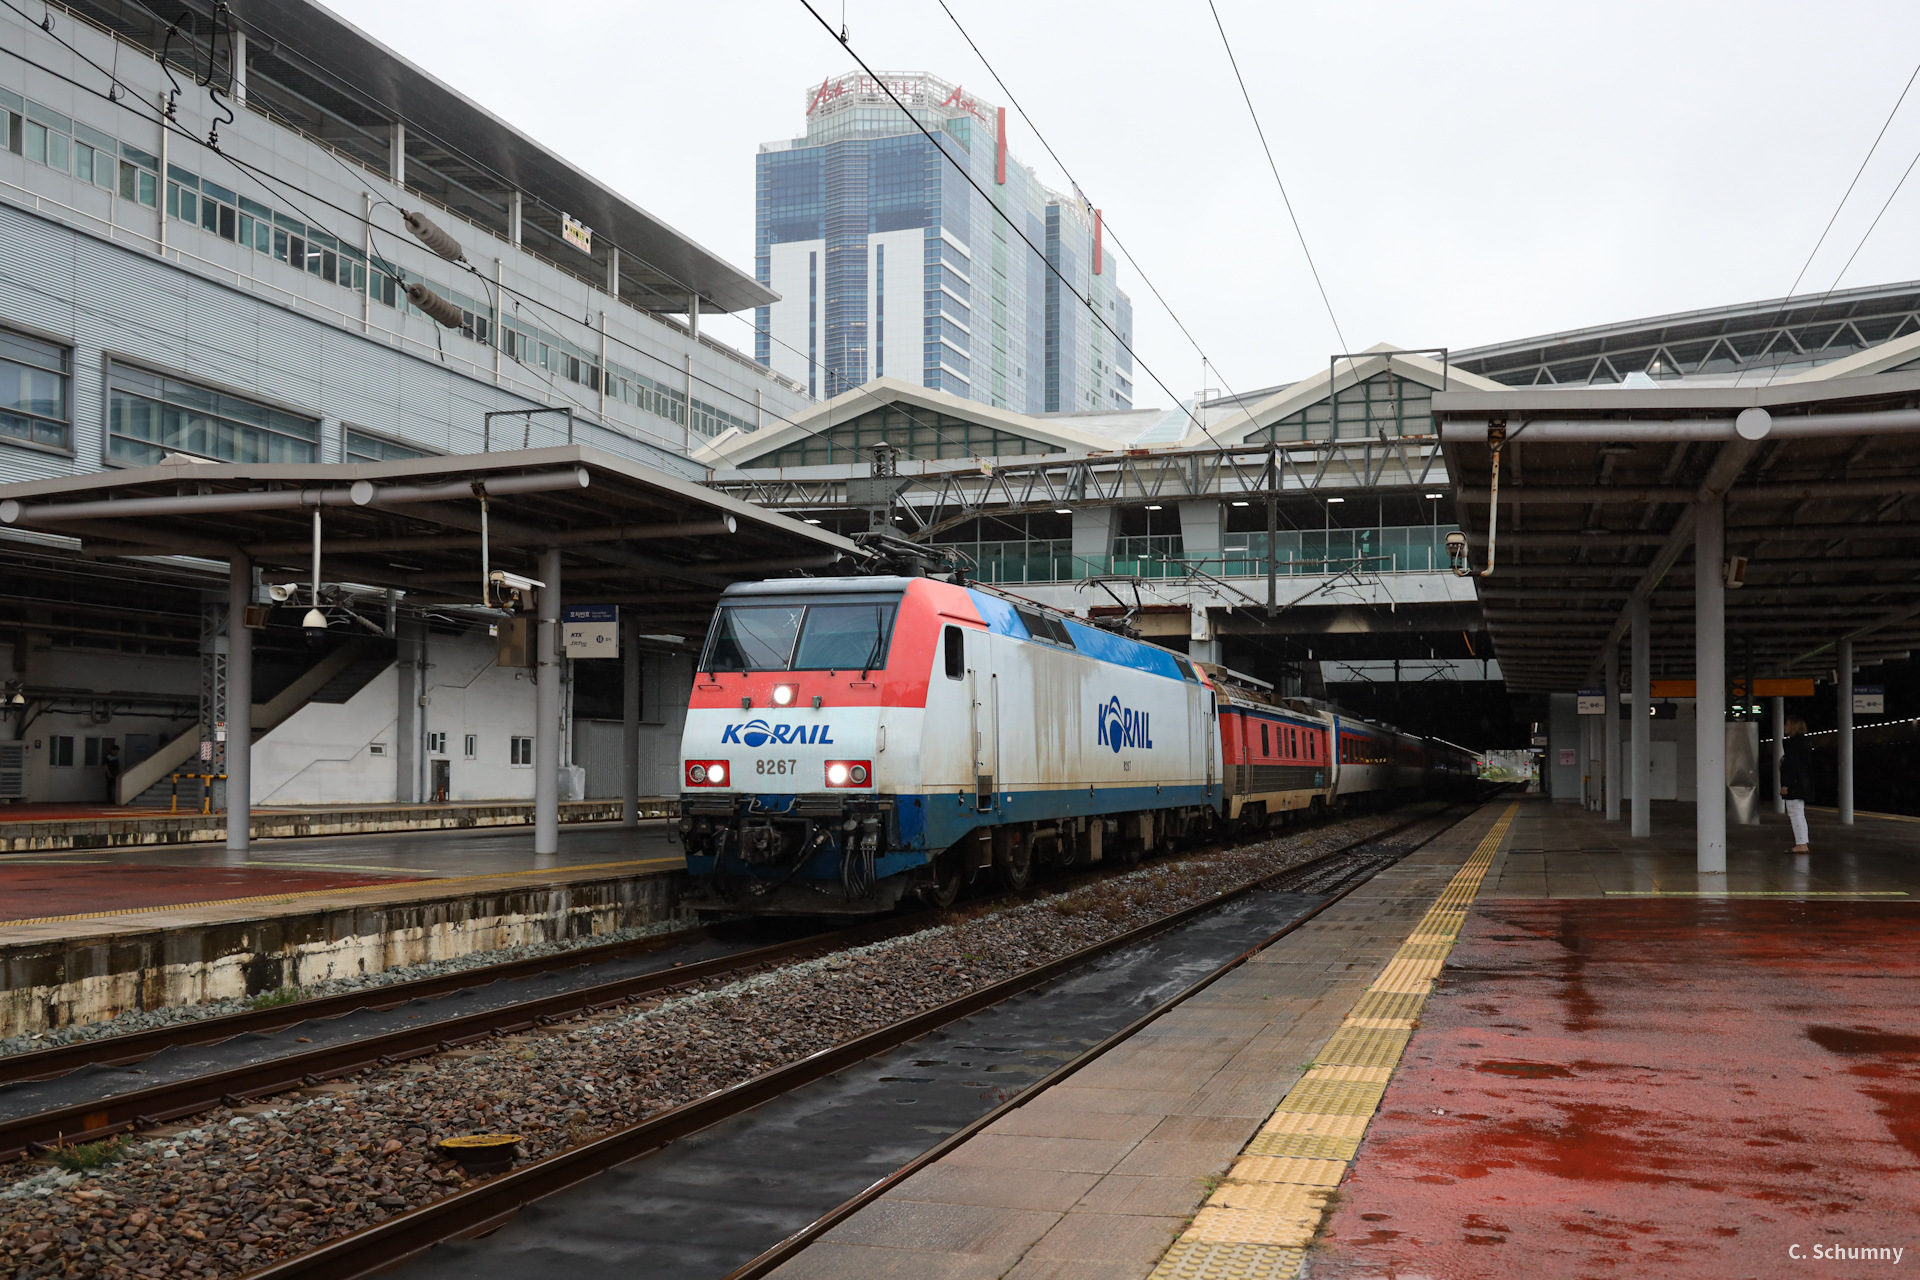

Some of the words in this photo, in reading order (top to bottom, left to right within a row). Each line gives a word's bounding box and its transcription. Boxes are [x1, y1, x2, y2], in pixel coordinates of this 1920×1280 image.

[860, 78, 921, 95] HOTEL
[941, 84, 987, 122] Asti
[721, 719, 834, 748] KORAIL
[1098, 695, 1152, 753] KORAIL
[756, 759, 797, 775] 8267
